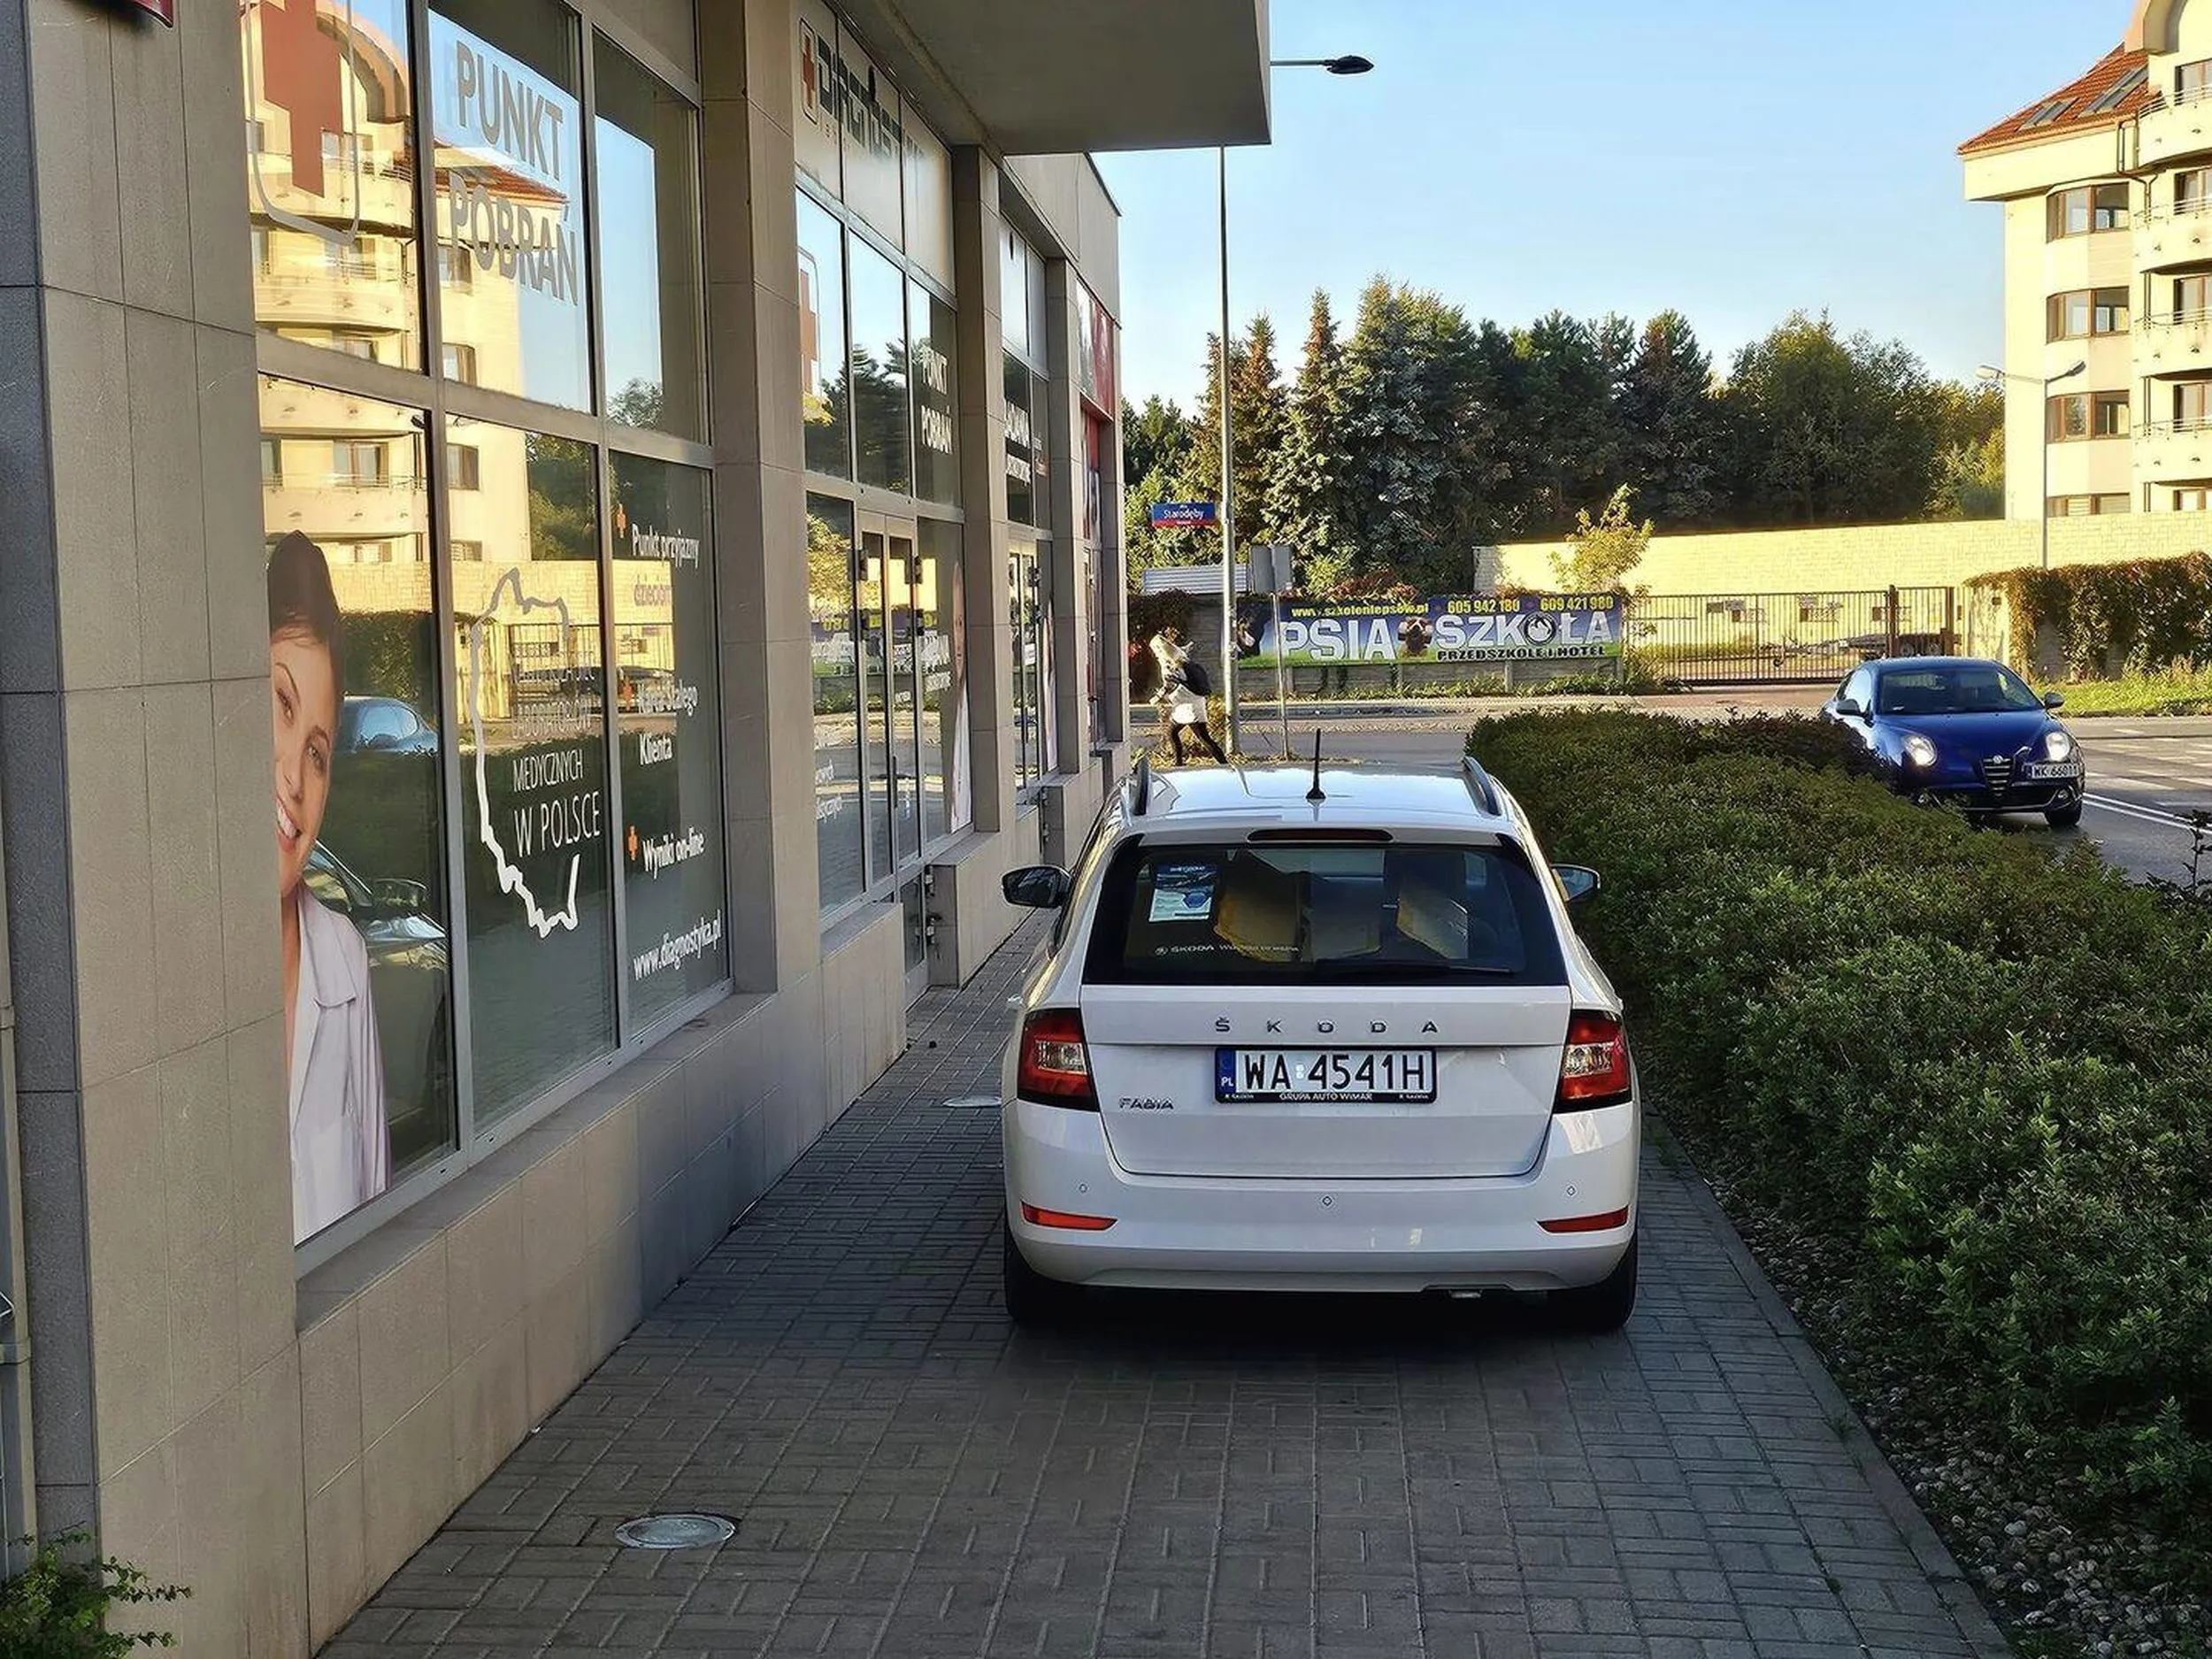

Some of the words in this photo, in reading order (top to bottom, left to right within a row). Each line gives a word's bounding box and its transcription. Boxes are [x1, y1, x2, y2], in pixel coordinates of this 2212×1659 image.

[456, 40, 563, 181] PUNKT
[449, 168, 578, 306] POBRAŃ
[632, 523, 660, 557] Punkt
[1448, 600, 1471, 614] 605
[1473, 599, 1496, 613] 942
[1540, 597, 1563, 611] 609
[1566, 597, 1588, 611] 421
[1590, 596, 1614, 610] 980
[1280, 618, 1397, 661] PSIA
[1435, 611, 1614, 650] SZKOŁA
[1437, 647, 1546, 661] PRZEDSZKOLE
[1556, 646, 1606, 657] HOTEL
[639, 733, 672, 765] Klienta
[512, 749, 584, 793] MEDYCZNYCH
[514, 806, 533, 858] W
[541, 791, 600, 851] POLSCE
[642, 833, 674, 879] Wyniki
[633, 909, 722, 981] www.diagnostyka.pl
[1215, 1017, 1438, 1033] ŠKODA
[1220, 1077, 1234, 1087] PL
[1244, 1054, 1292, 1090] WA
[1307, 1054, 1425, 1090] 4541H
[1119, 1097, 1174, 1110] FABIA
